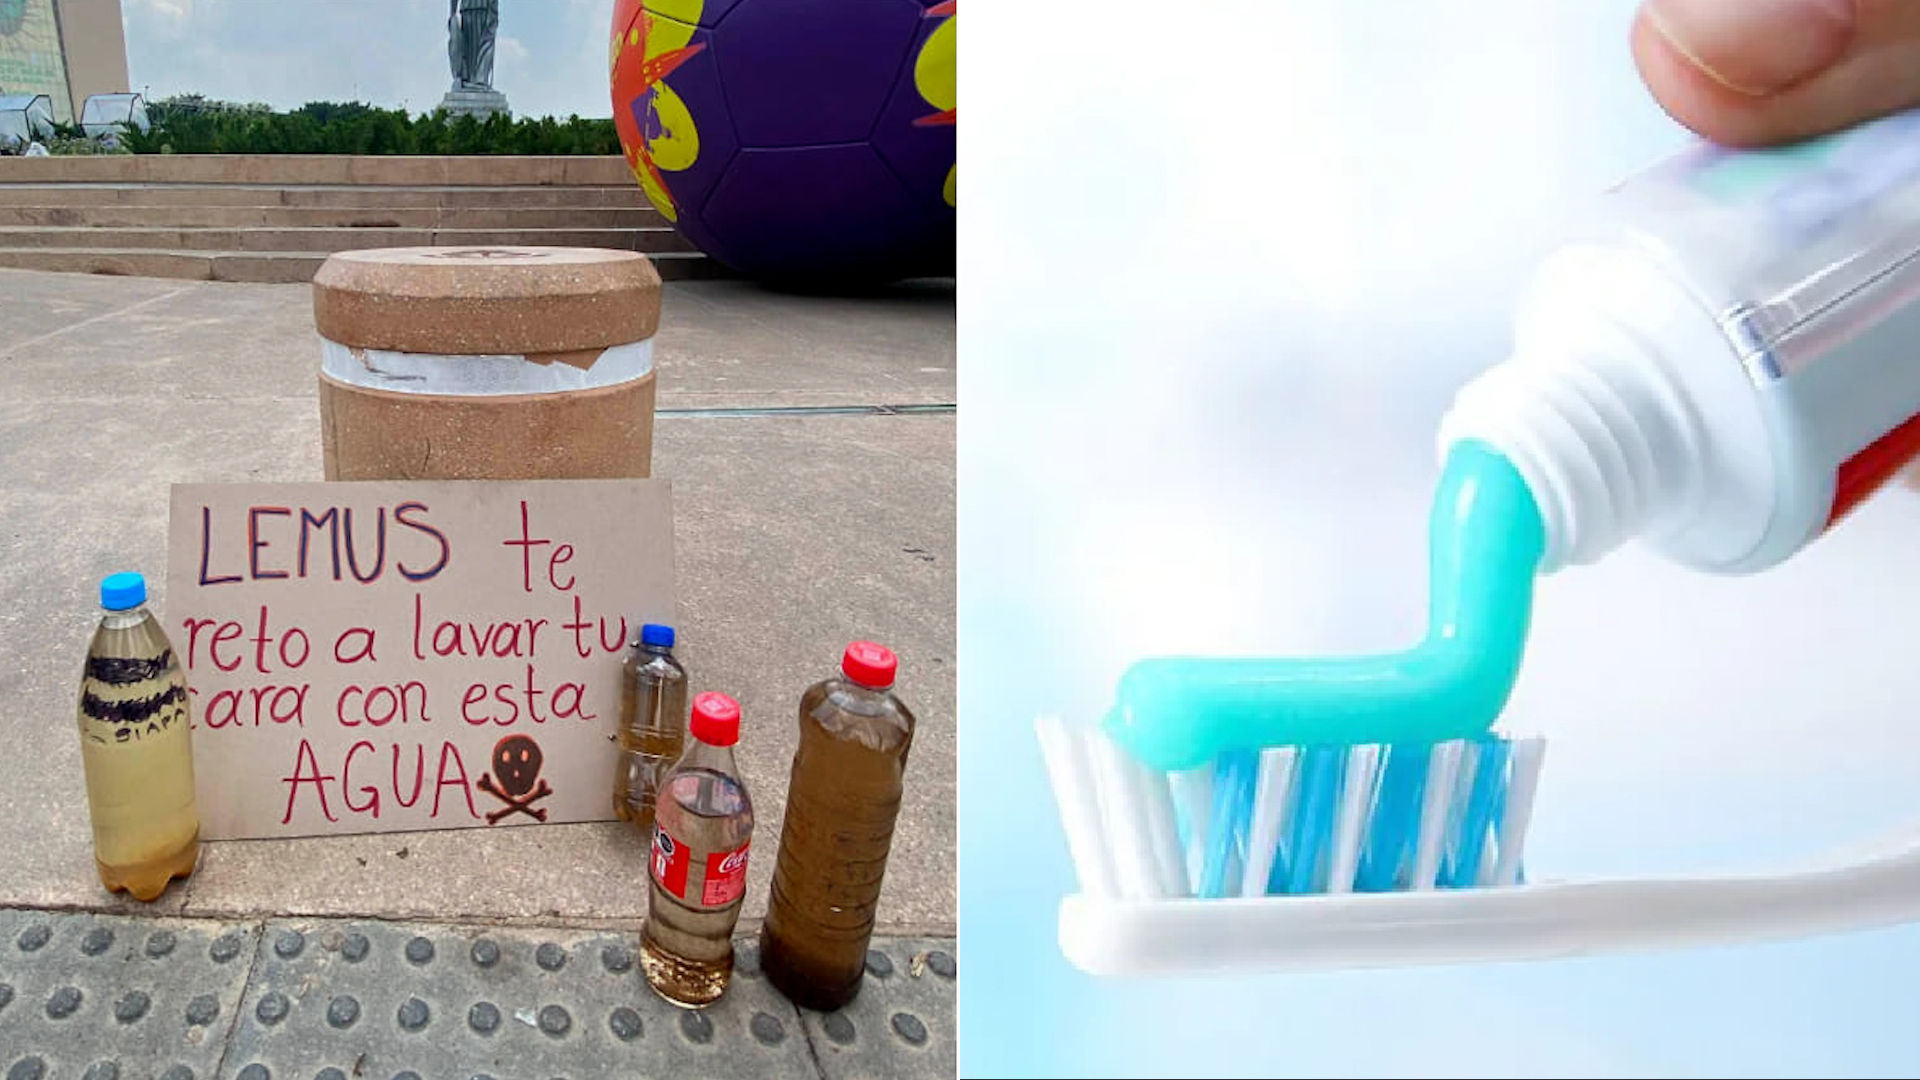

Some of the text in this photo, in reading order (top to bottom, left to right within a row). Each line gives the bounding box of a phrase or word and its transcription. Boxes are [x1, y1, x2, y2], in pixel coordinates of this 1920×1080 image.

[199, 499, 577, 592] LEMUS te
[183, 593, 628, 674] reto a lavar tu
[188, 663, 598, 729] ara con esta
[281, 738, 482, 825] AGUA
